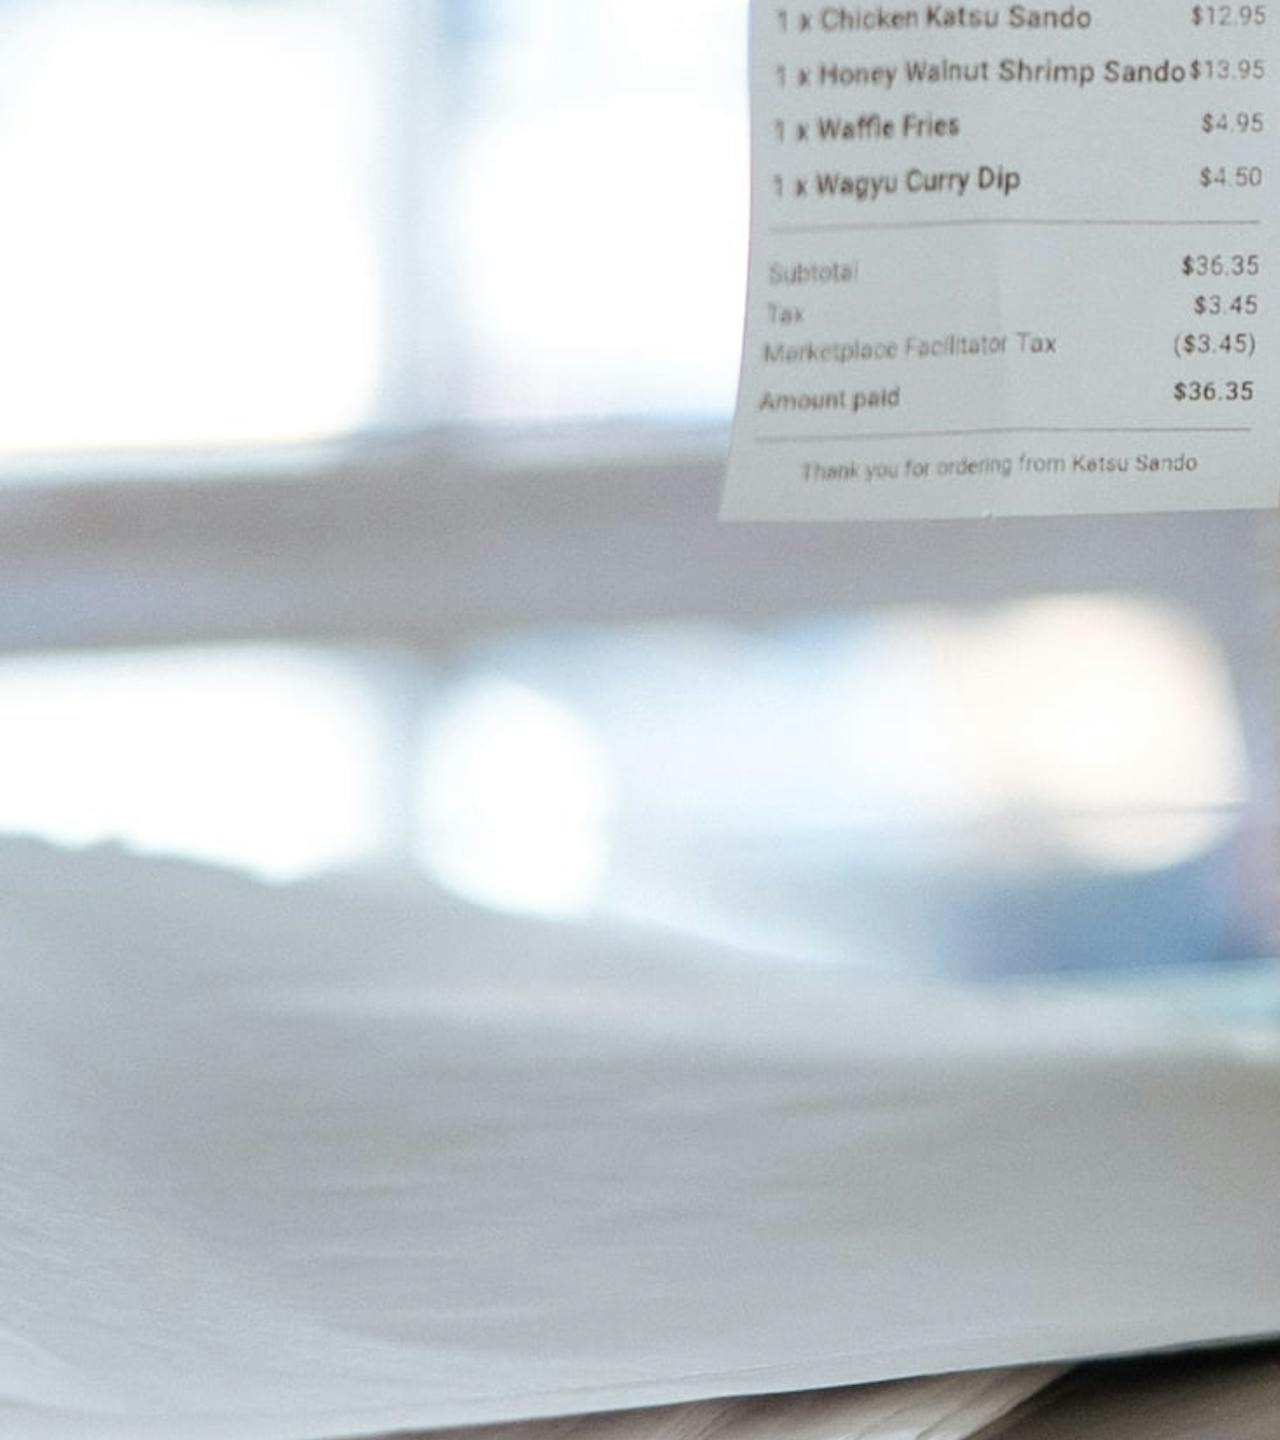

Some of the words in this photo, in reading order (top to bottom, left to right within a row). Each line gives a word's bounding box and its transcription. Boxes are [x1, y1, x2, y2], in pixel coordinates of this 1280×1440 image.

[799, 13, 811, 32] x
[819, 6, 919, 32] Chicken
[925, 5, 999, 29] Katsu
[1008, 4, 1092, 30] Sando
[1191, 4, 1266, 27] $12.95
[798, 68, 810, 87] x
[818, 63, 897, 90] Honey
[905, 58, 989, 83] Walnut
[999, 58, 1095, 88] Shrimp
[1103, 59, 1186, 83] Sando
[1189, 58, 1264, 81] $13.95
[796, 123, 808, 142] x
[817, 113, 895, 140] Waffle
[902, 113, 960, 138] Fries
[1201, 112, 1263, 134] $4.95
[795, 179, 807, 197] x
[816, 173, 898, 201] Wagyu
[905, 168, 970, 197] Curry
[977, 165, 1021, 197] Dip
[1200, 166, 1262, 188] $4.50
[769, 262, 858, 286] Subtotal
[1181, 254, 1259, 277] $36.35
[757, 390, 846, 412] Amount
[851, 386, 900, 414] paid
[1174, 380, 1253, 402] $36.35
